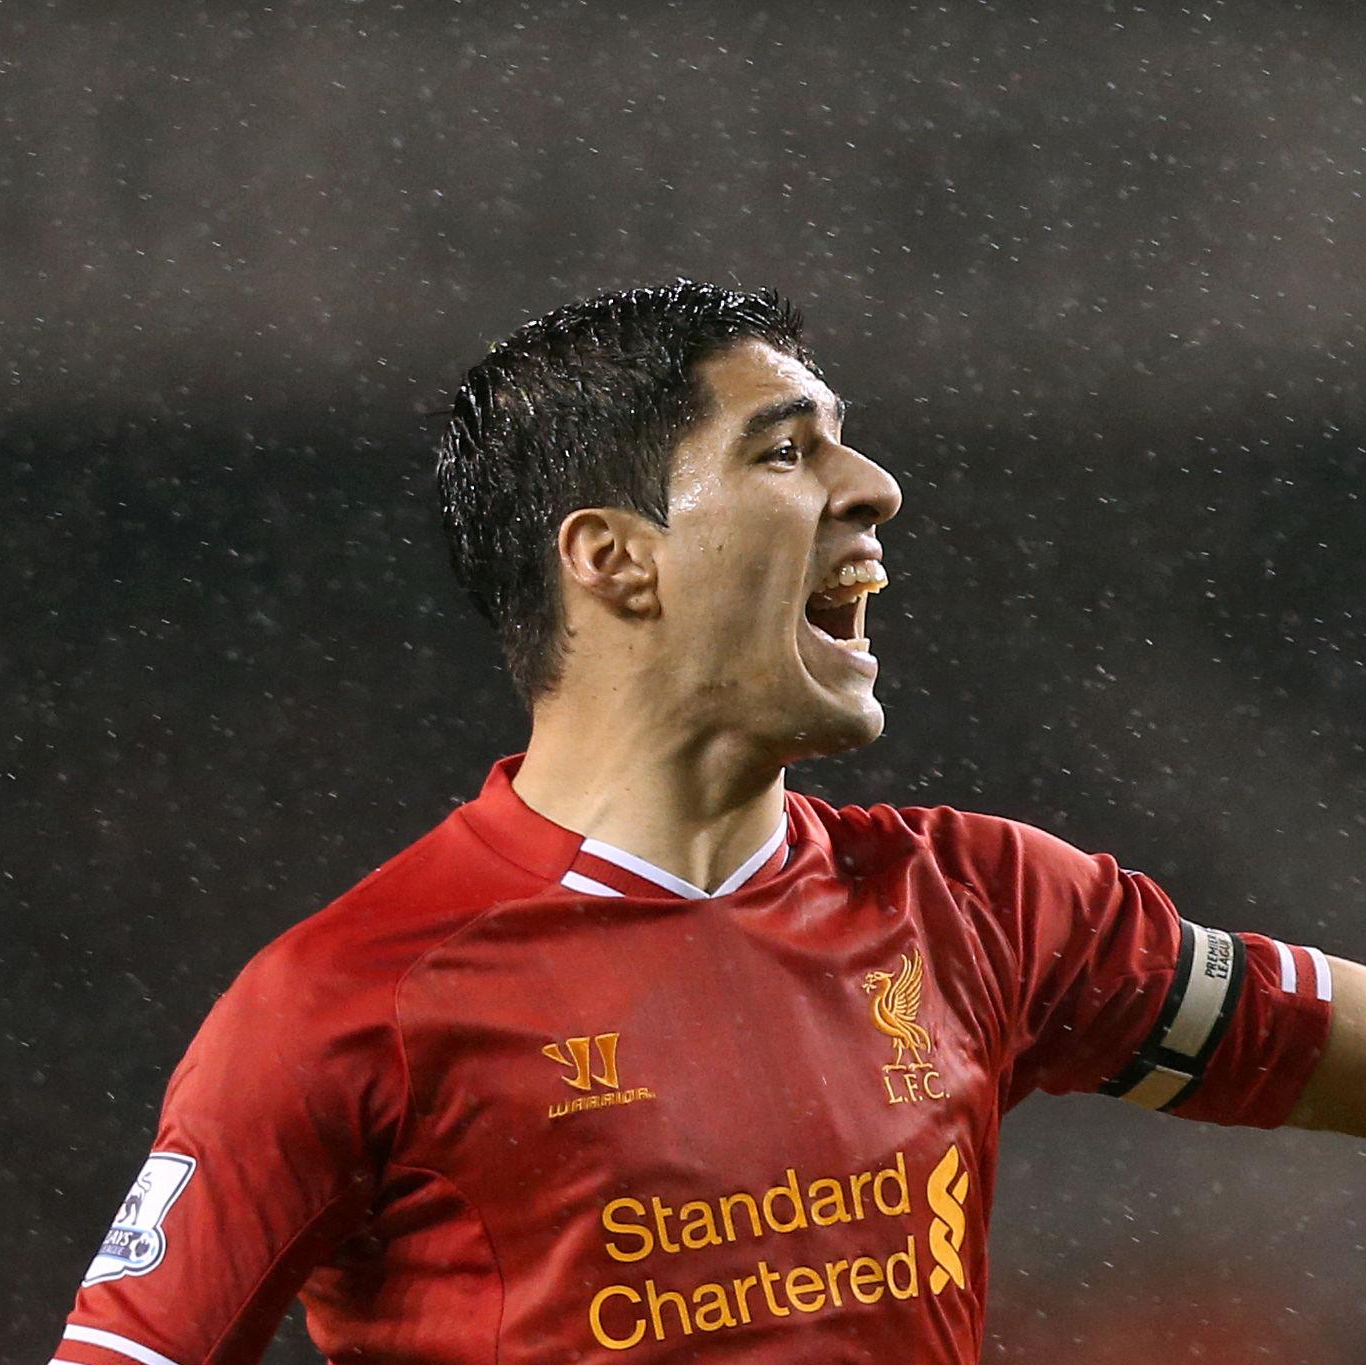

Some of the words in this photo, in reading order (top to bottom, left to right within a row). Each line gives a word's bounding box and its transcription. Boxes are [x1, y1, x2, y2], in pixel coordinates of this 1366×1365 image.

[548, 1087, 649, 1118] WARRIOR
[883, 1071, 951, 1104] L.F.C.
[602, 1151, 912, 1263] Standard
[589, 1235, 919, 1351] Chartered
